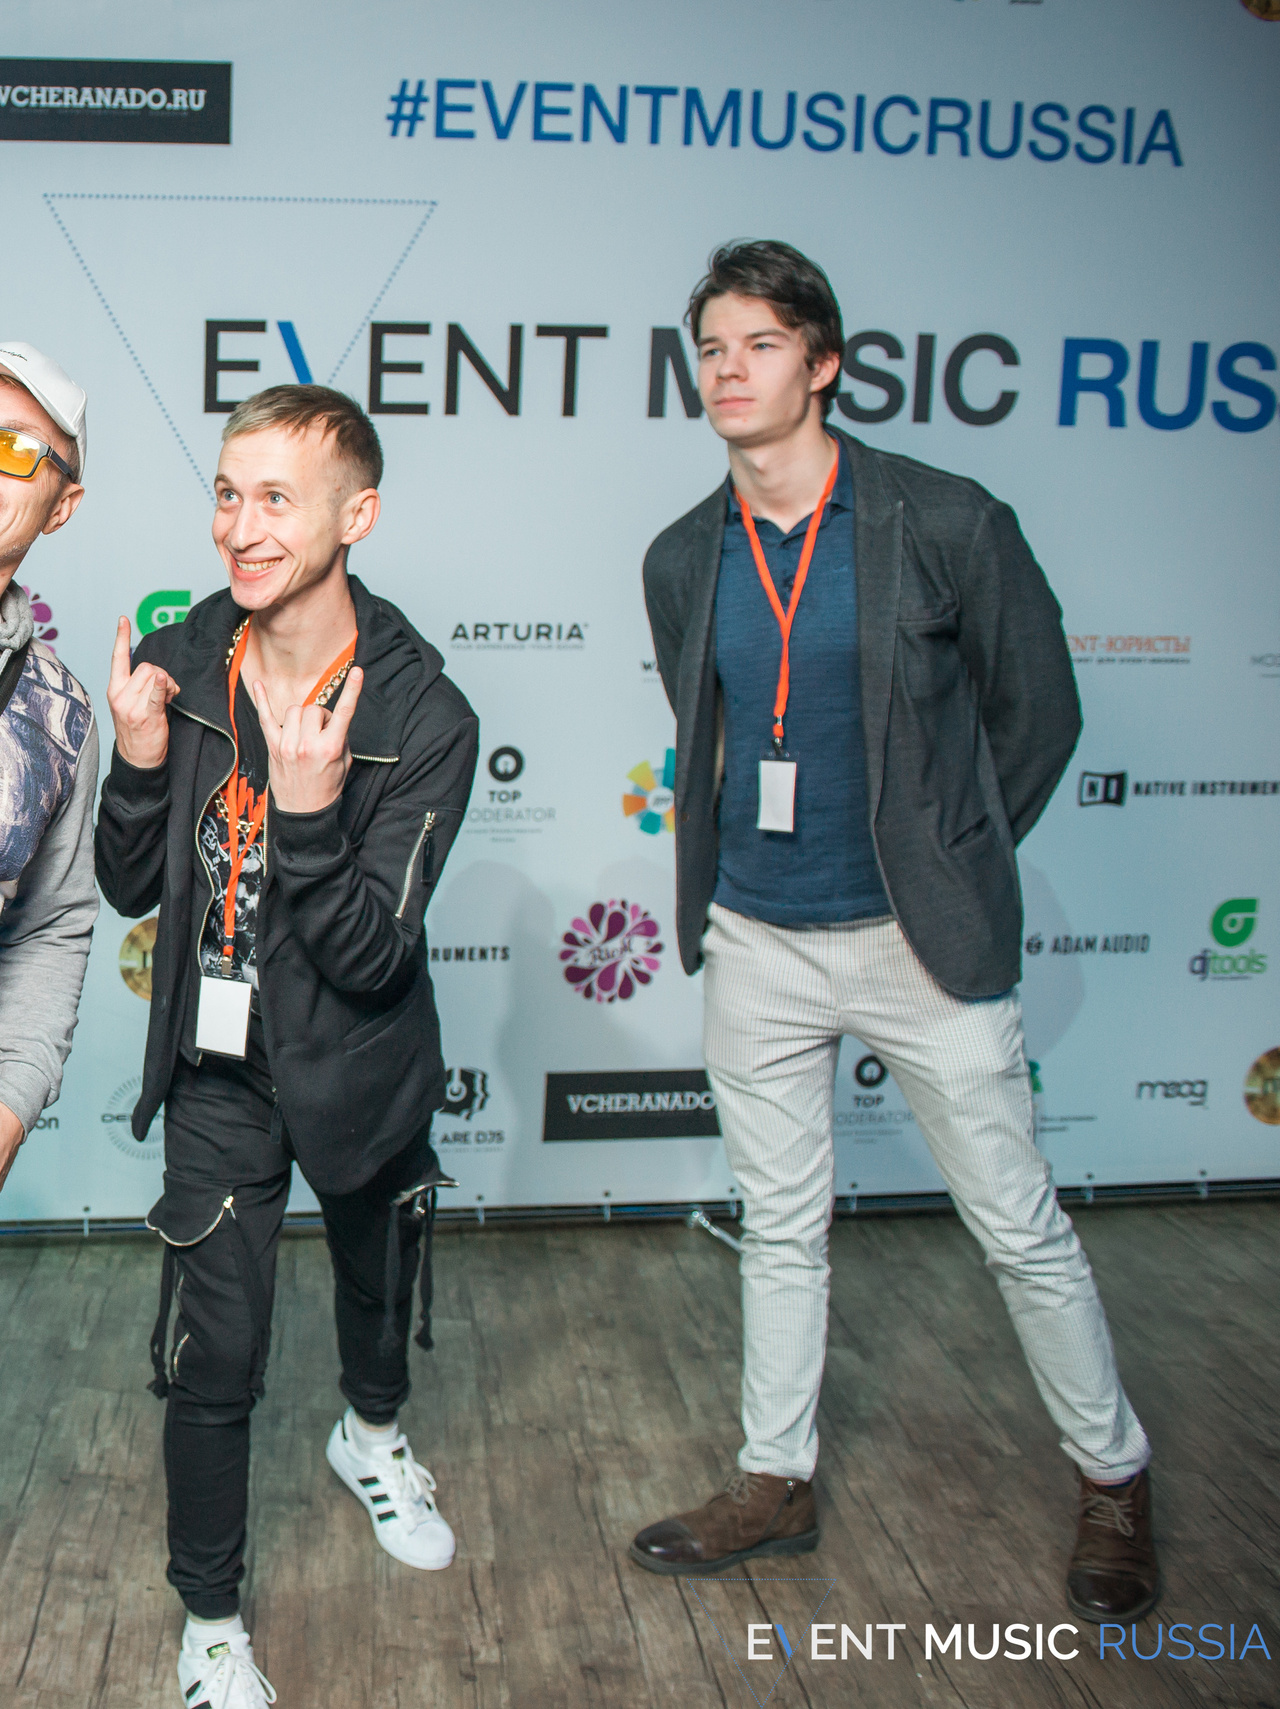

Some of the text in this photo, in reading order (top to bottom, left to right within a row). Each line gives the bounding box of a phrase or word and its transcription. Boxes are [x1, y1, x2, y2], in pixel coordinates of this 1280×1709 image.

[386, 79, 1184, 168] #EVENTMUSICRUSSIA
[646, 326, 1020, 426] MSIC
[1057, 336, 1280, 434] RUS
[451, 622, 585, 642] ARTURIA
[487, 790, 522, 803] TOP
[1133, 781, 1187, 796] NATIVE
[1191, 781, 1280, 796] INSTRUMEN
[467, 807, 557, 823] ODERATOR
[1051, 932, 1151, 955] ADAM AUDIO
[430, 946, 510, 962] RUMENTS
[566, 1090, 717, 1115] VCHERANADO
[852, 1094, 885, 1109] TOP
[1135, 1079, 1208, 1107] moog
[833, 1109, 915, 1127] ODERATOR
